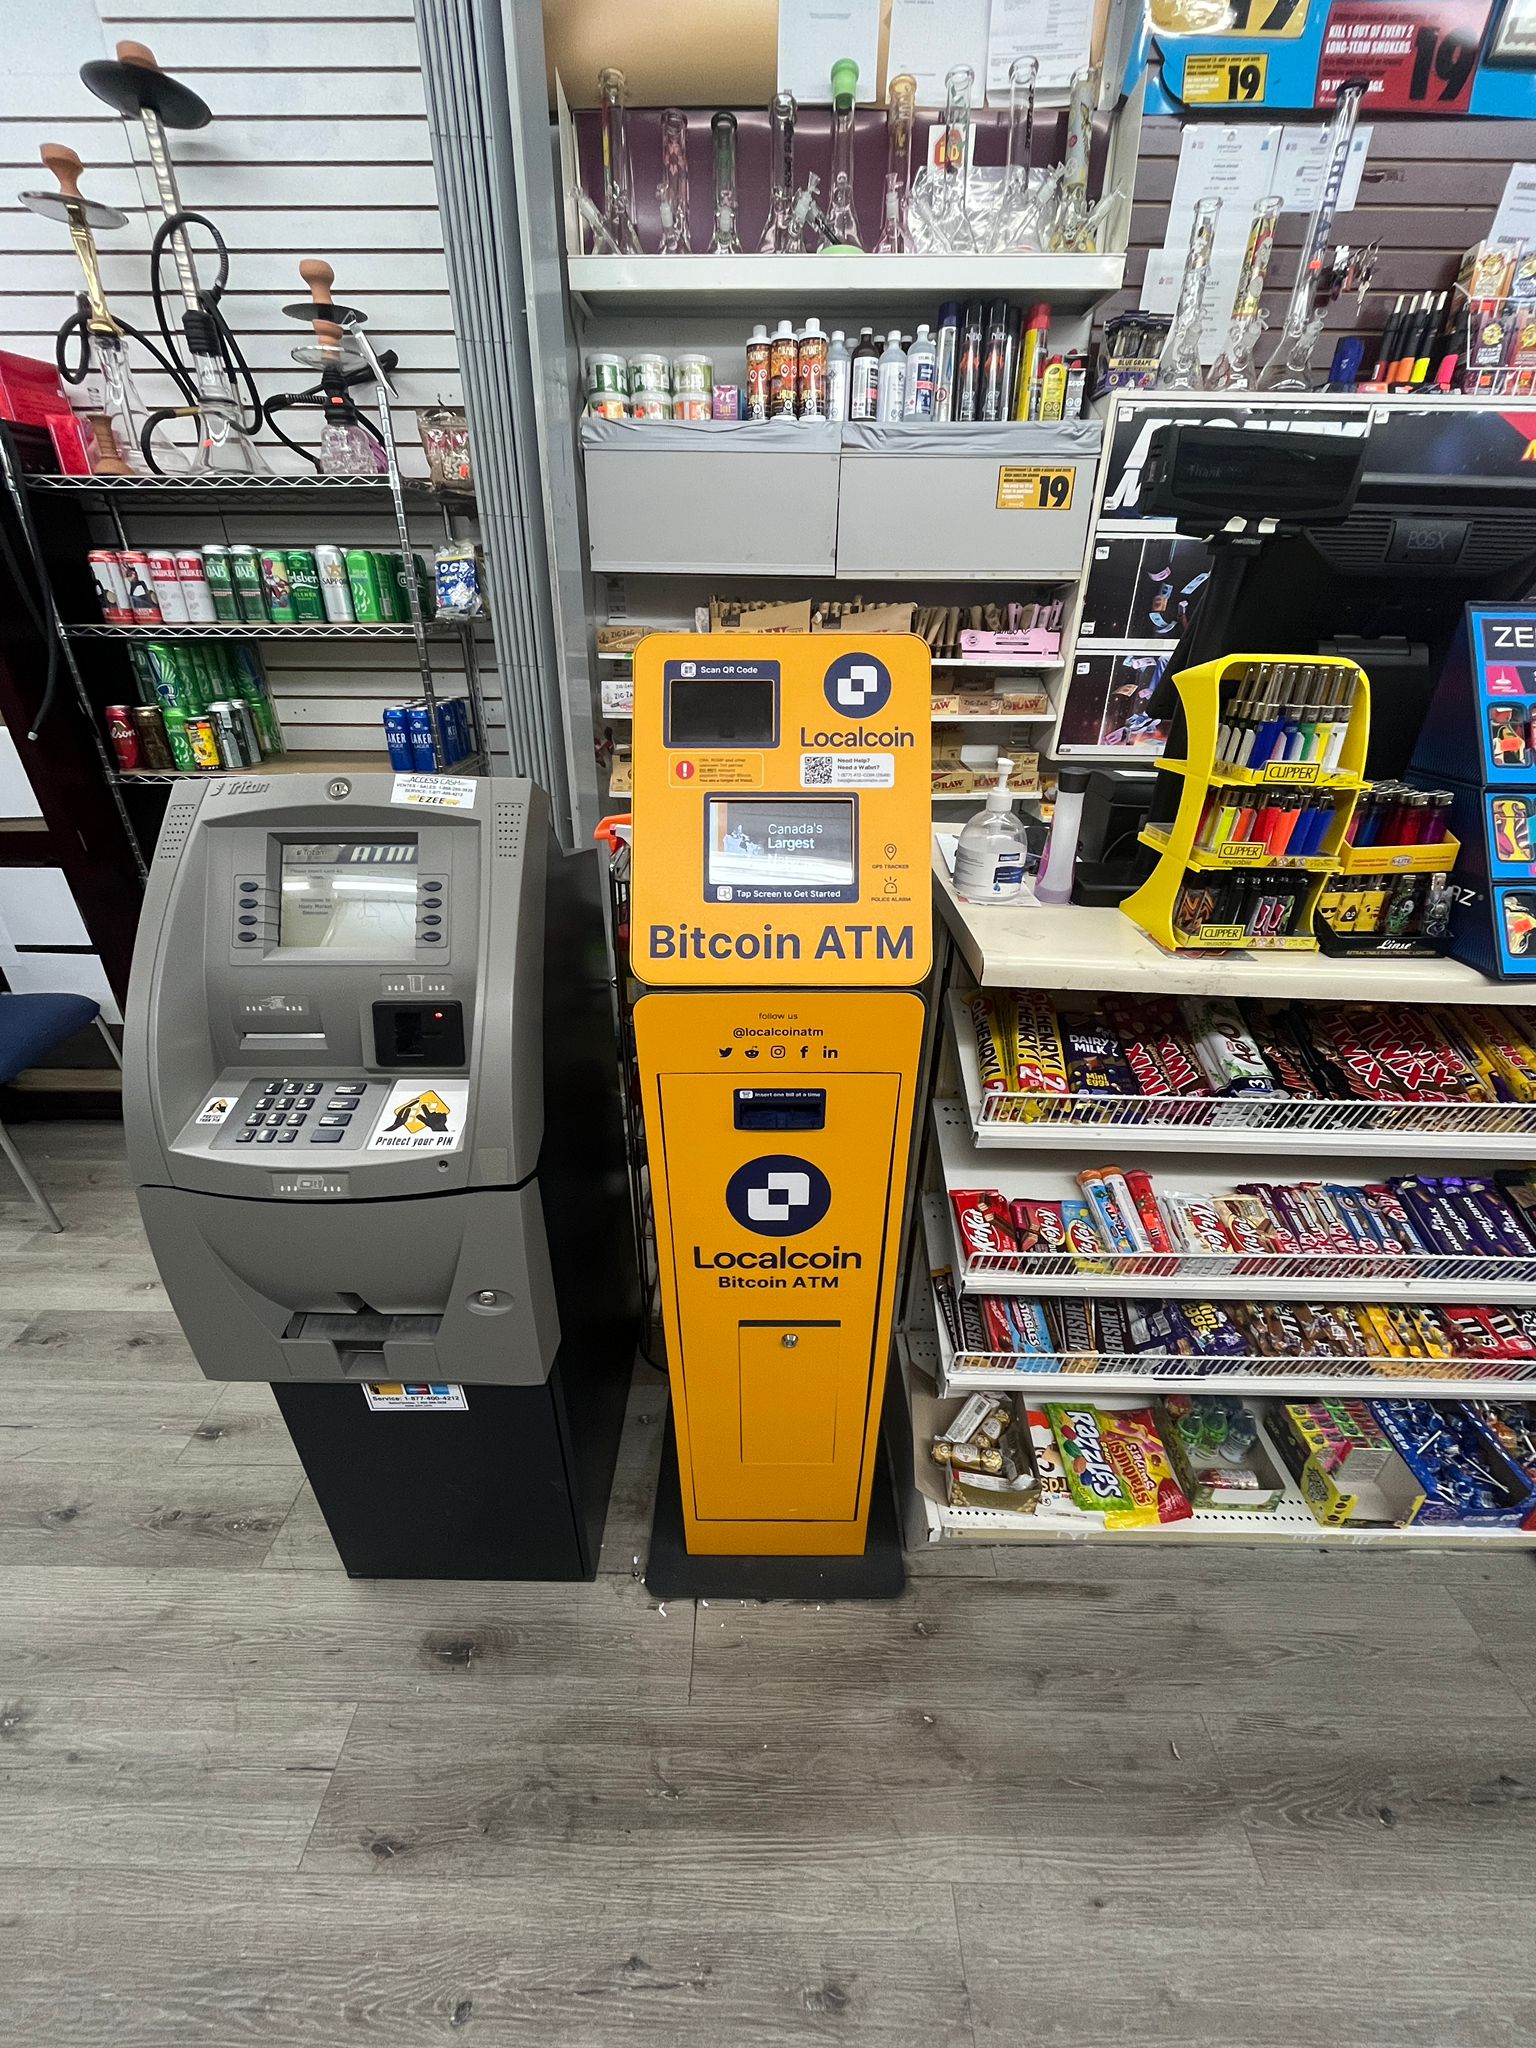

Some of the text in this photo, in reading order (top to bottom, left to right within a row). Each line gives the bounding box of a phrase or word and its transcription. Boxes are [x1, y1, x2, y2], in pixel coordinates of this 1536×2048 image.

[1328, 25, 1347, 38] KILL
[1352, 25, 1369, 38] OUT
[1370, 25, 1380, 38] OF
[1381, 24, 1407, 38] EVERY
[1407, 25, 1415, 38] 2
[1325, 41, 1371, 54] LONG-TERM
[1409, 26, 1480, 101] 19
[1229, 65, 1261, 100] 19
[1039, 475, 1070, 507] 19
[1408, 530, 1449, 550] POSX
[205, 564, 227, 578] DAB
[235, 564, 256, 578] DAB
[1492, 626, 1536, 647] ZE
[723, 666, 735, 674] QR
[736, 666, 758, 674] Code
[1013, 700, 1041, 711] RAW
[800, 727, 914, 748] Localcoin
[1269, 766, 1314, 779] CLIPPER
[410, 776, 439, 784] ACCESS
[941, 780, 964, 788] RAW
[1014, 778, 1034, 786] RAW
[228, 781, 270, 795] Triton
[768, 823, 823, 835] Canada's
[767, 837, 815, 851] Largest
[350, 846, 415, 862] ATM
[1223, 846, 1260, 857] CLIPPER
[736, 889, 841, 898] Tap Screen to Get Started
[1204, 928, 1239, 939] CLIPPER
[649, 923, 914, 960] Bitcoin ATM
[758, 1012, 785, 1020] follow
[733, 1027, 824, 1039] @localcoinatm
[1017, 1003, 1041, 1060] HENRY!
[1038, 1006, 1063, 1071] HENRY!
[1069, 1033, 1110, 1047] DAIRY
[974, 1016, 1002, 1081] HENRY!
[1074, 1042, 1107, 1055] MILK
[1325, 1013, 1392, 1090] TWIX
[1360, 1013, 1434, 1091] TWIX
[1086, 1072, 1107, 1081] Mini
[1086, 1079, 1110, 1088] Eggs
[376, 1136, 454, 1147] Protect your PIN
[1438, 1197, 1473, 1241] DAIRY MILK
[1462, 1197, 1498, 1241] DAIRY MILK
[693, 1246, 862, 1269] Localcoin
[718, 1276, 839, 1289] Bitcoin ATM
[1183, 1303, 1212, 1335] Eggs
[1197, 1302, 1218, 1329] Mini
